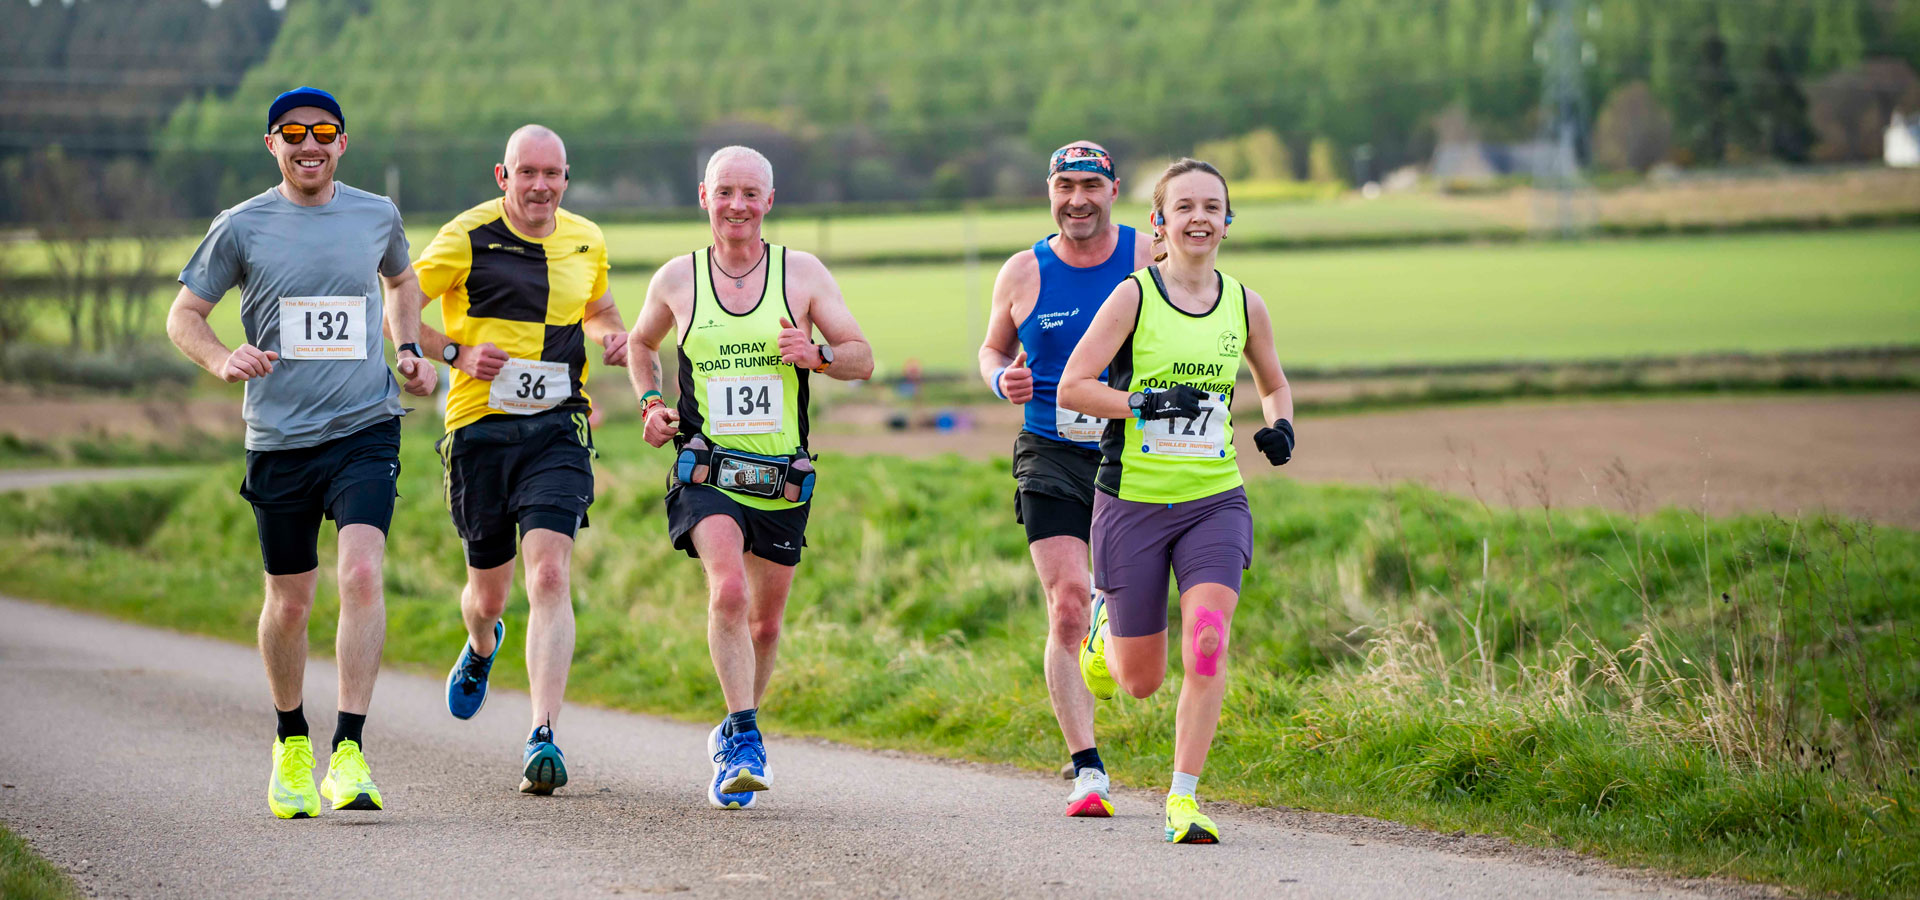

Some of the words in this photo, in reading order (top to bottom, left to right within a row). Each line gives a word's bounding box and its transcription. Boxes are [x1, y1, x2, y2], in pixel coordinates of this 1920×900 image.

[305, 311, 349, 340] 132
[720, 342, 766, 356] MORAY
[696, 359, 731, 373] ROAD
[1172, 362, 1223, 377] MORAY
[516, 373, 546, 400] 36
[1140, 378, 1178, 391] ROAD
[1185, 381, 1231, 396] RUNNER
[726, 386, 771, 416] 134
[1168, 406, 1214, 436] 127
